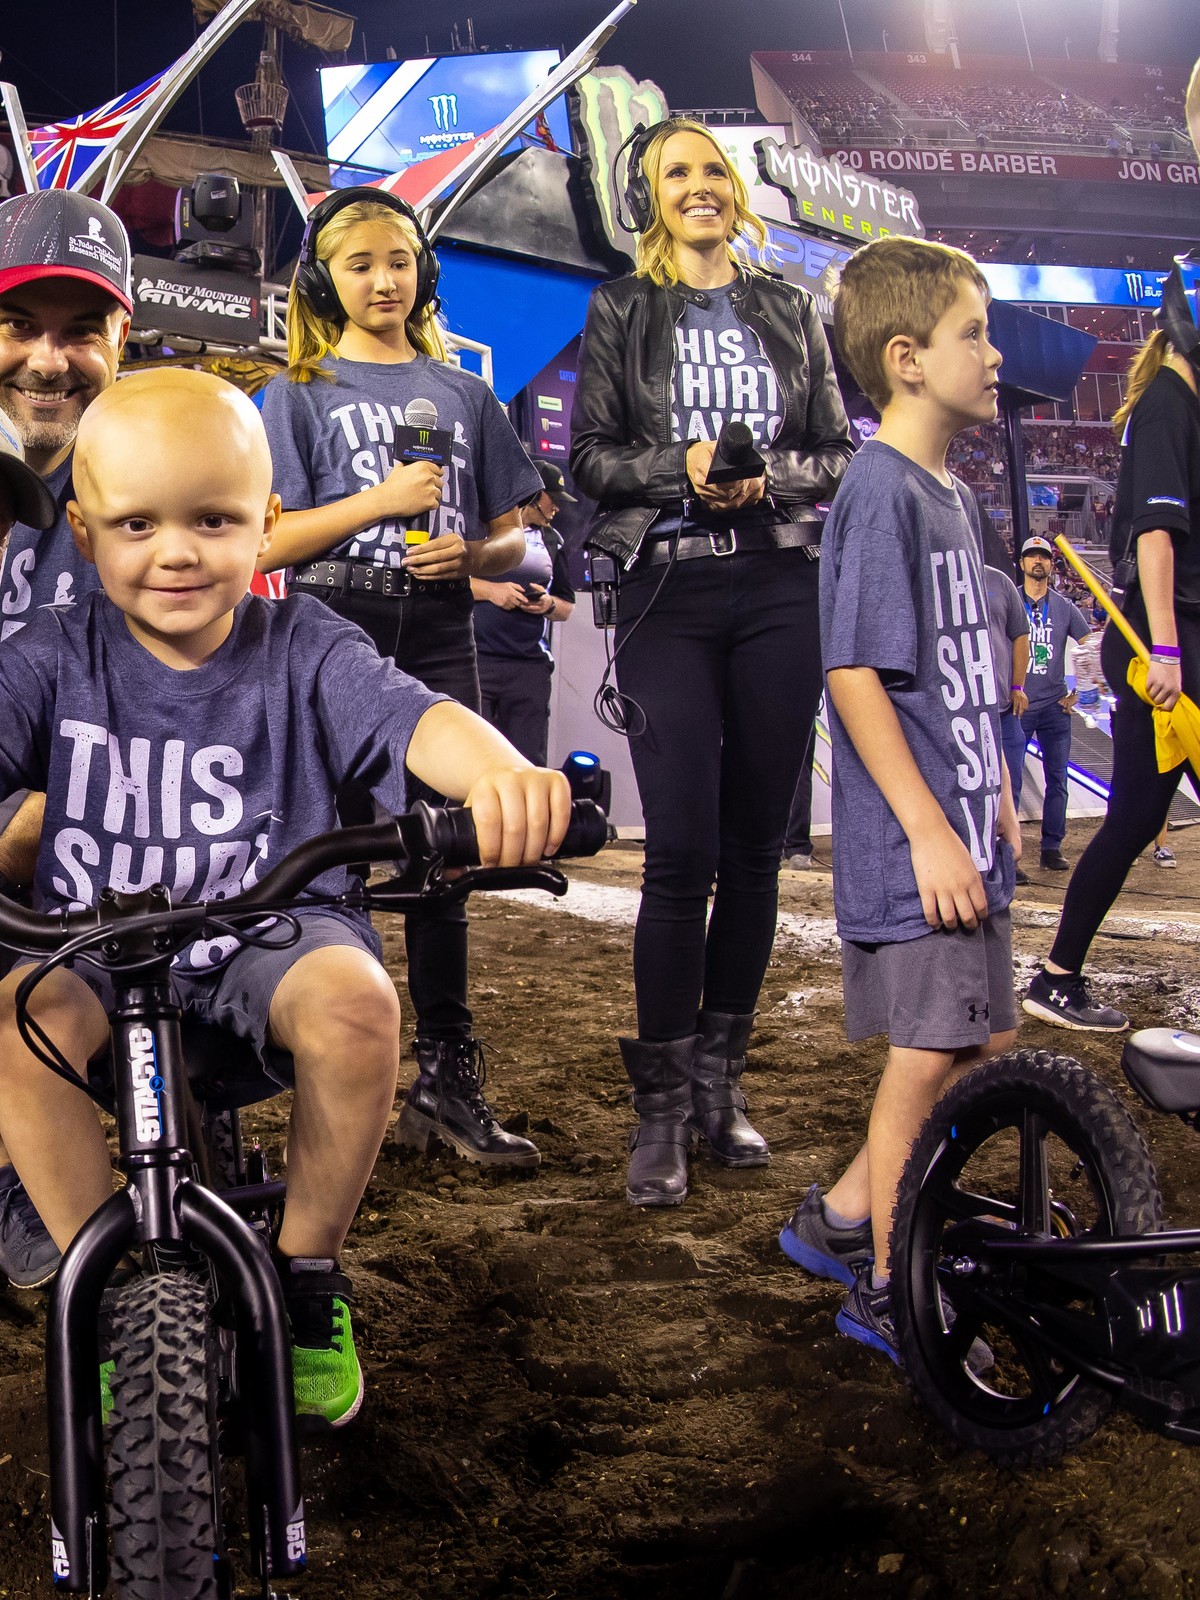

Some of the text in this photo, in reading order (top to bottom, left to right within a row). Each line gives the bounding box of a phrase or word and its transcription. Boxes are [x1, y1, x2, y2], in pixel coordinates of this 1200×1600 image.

[791, 53, 812, 62] 344
[906, 55, 927, 64] 343
[1145, 67, 1163, 77] 342
[837, 151, 863, 169] 20
[960, 153, 1058, 175] BARBER
[1118, 161, 1162, 181] JON
[768, 146, 921, 231] MONSTER
[802, 200, 890, 239] ENERG
[69, 244, 100, 260] Research
[155, 279, 251, 305] ROCKY MOUNTAIN
[675, 326, 746, 365] HIS
[682, 363, 778, 412] HIRT
[60, 719, 244, 839] THIS
[129, 1027, 161, 1142] STACYC
